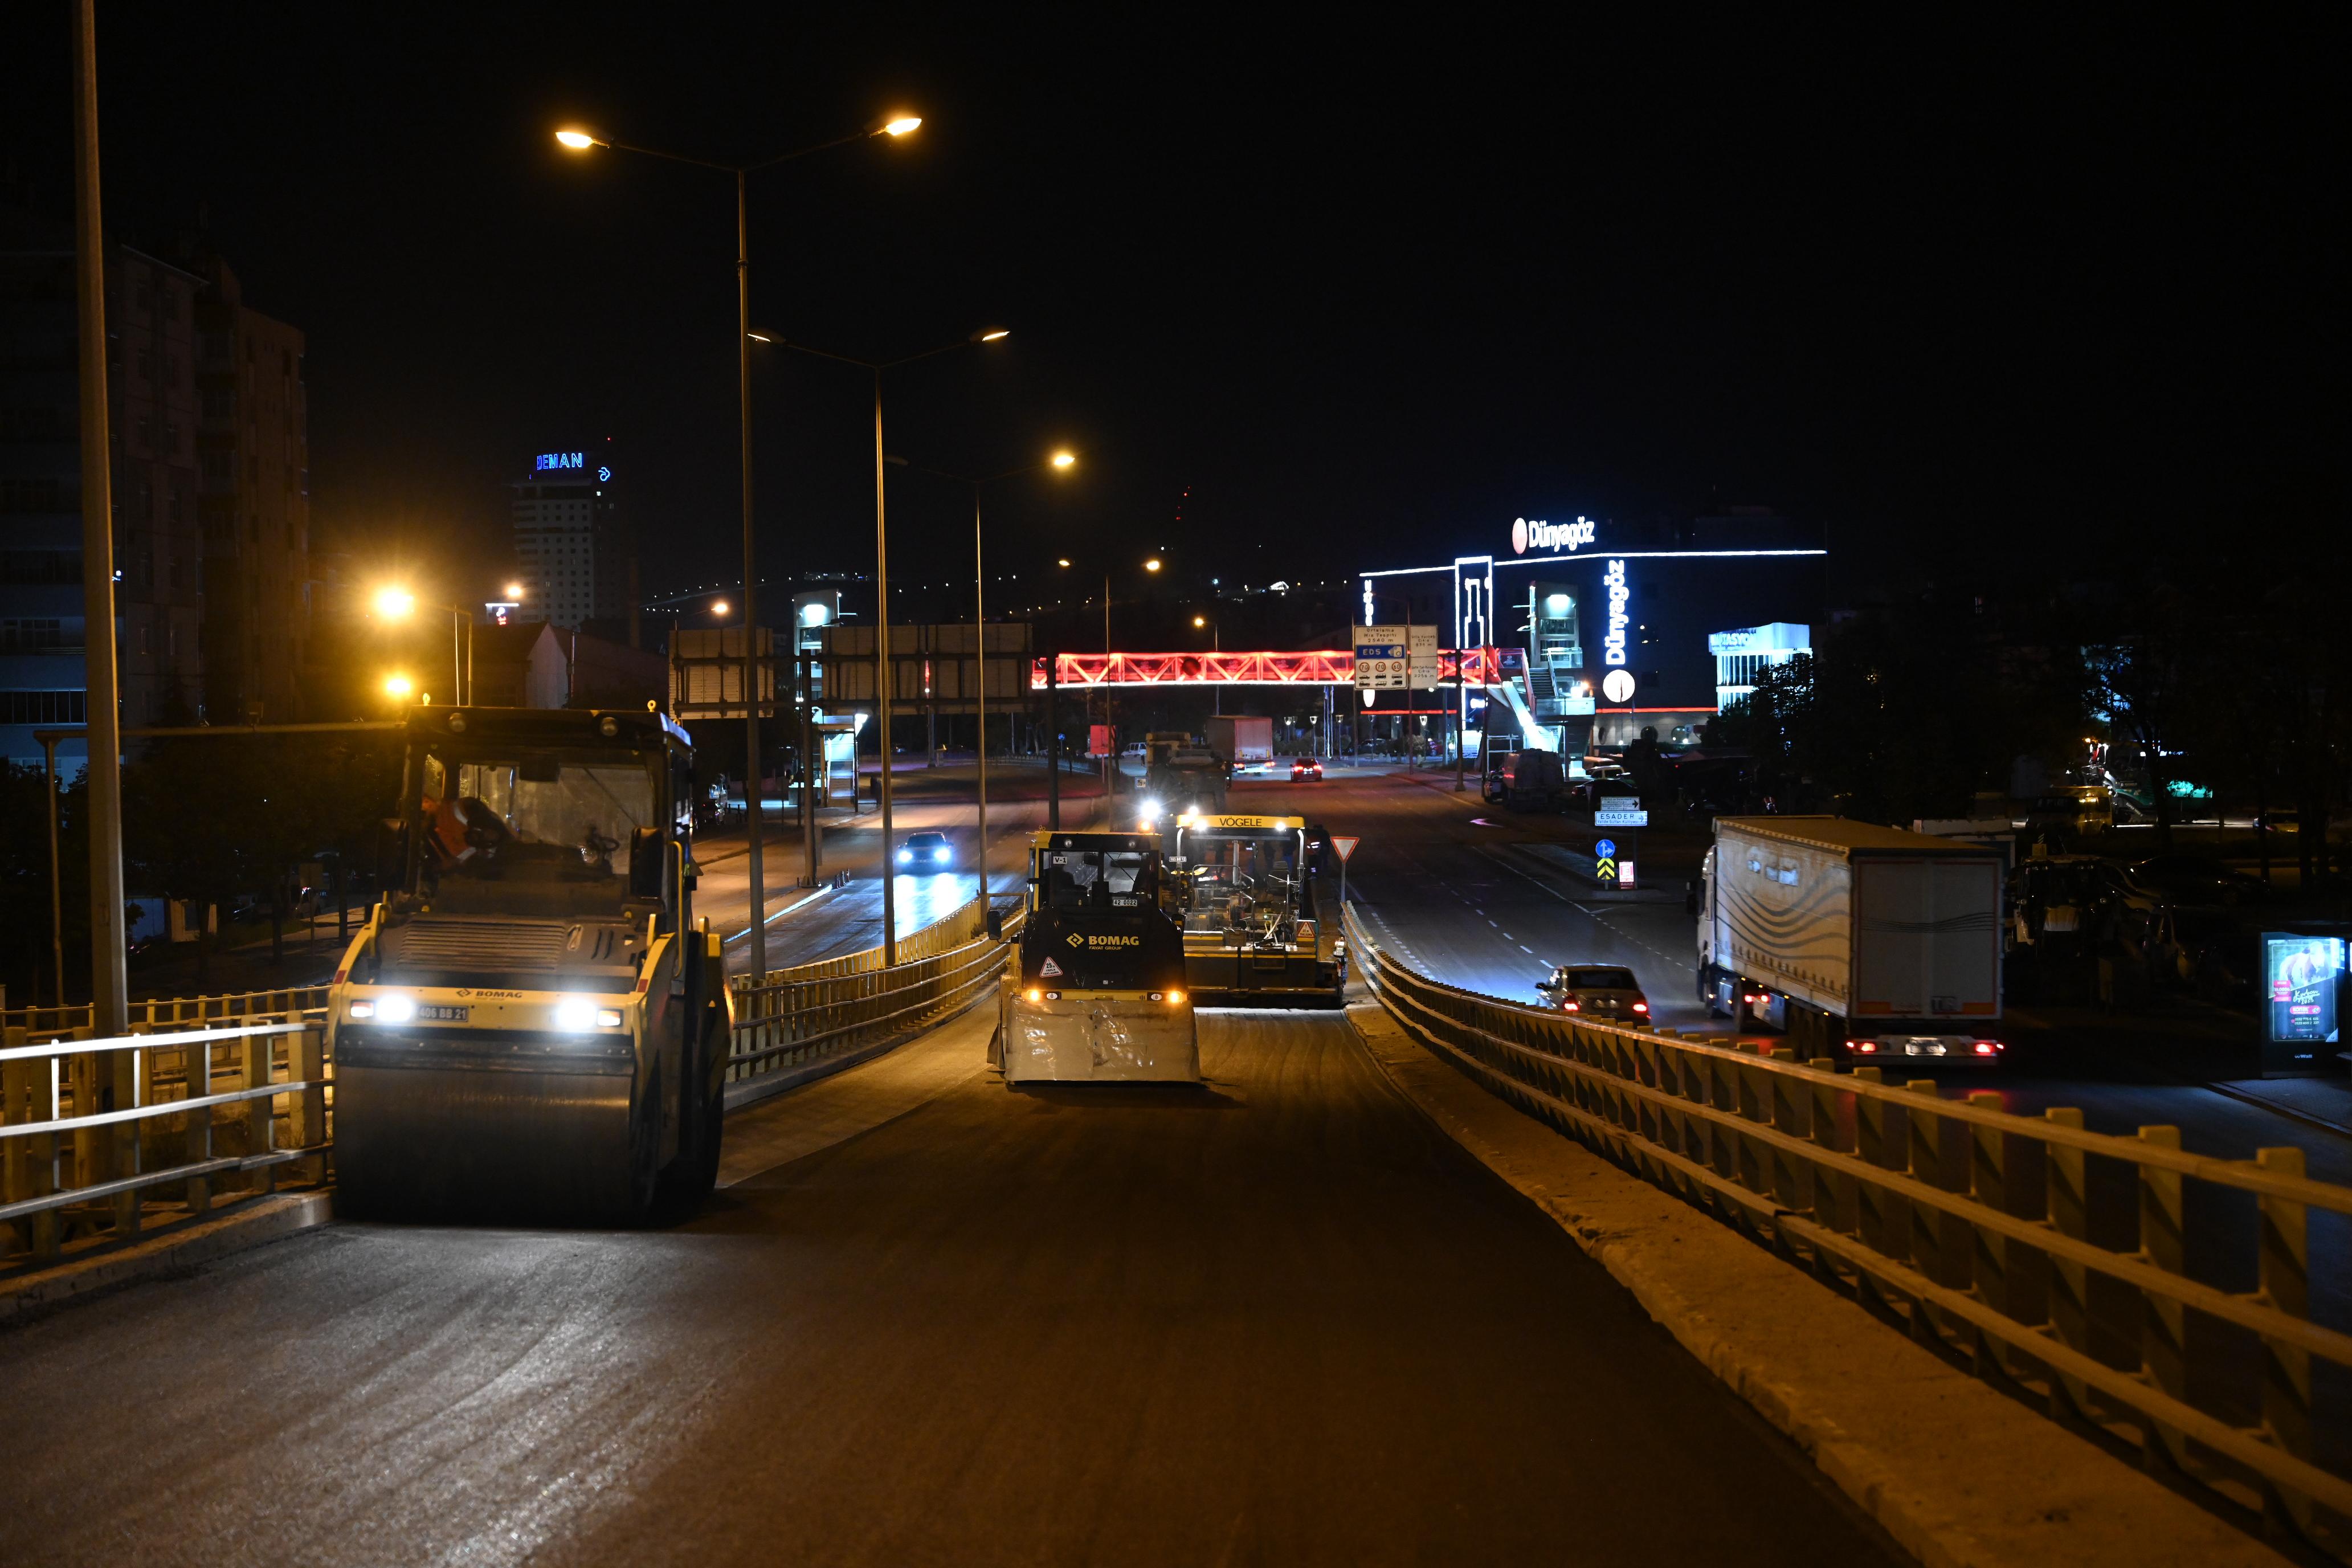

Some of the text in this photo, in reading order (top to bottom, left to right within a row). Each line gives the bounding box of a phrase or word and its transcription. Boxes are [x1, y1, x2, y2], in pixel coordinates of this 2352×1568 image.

[1529, 516, 1595, 552] Dünyagöz
[1604, 560, 1630, 665] Dünyagöz
[1219, 816, 1262, 826] VÖGELE
[1089, 936, 1139, 945] BOMAG
[419, 1007, 466, 1019] 406 BB 21
